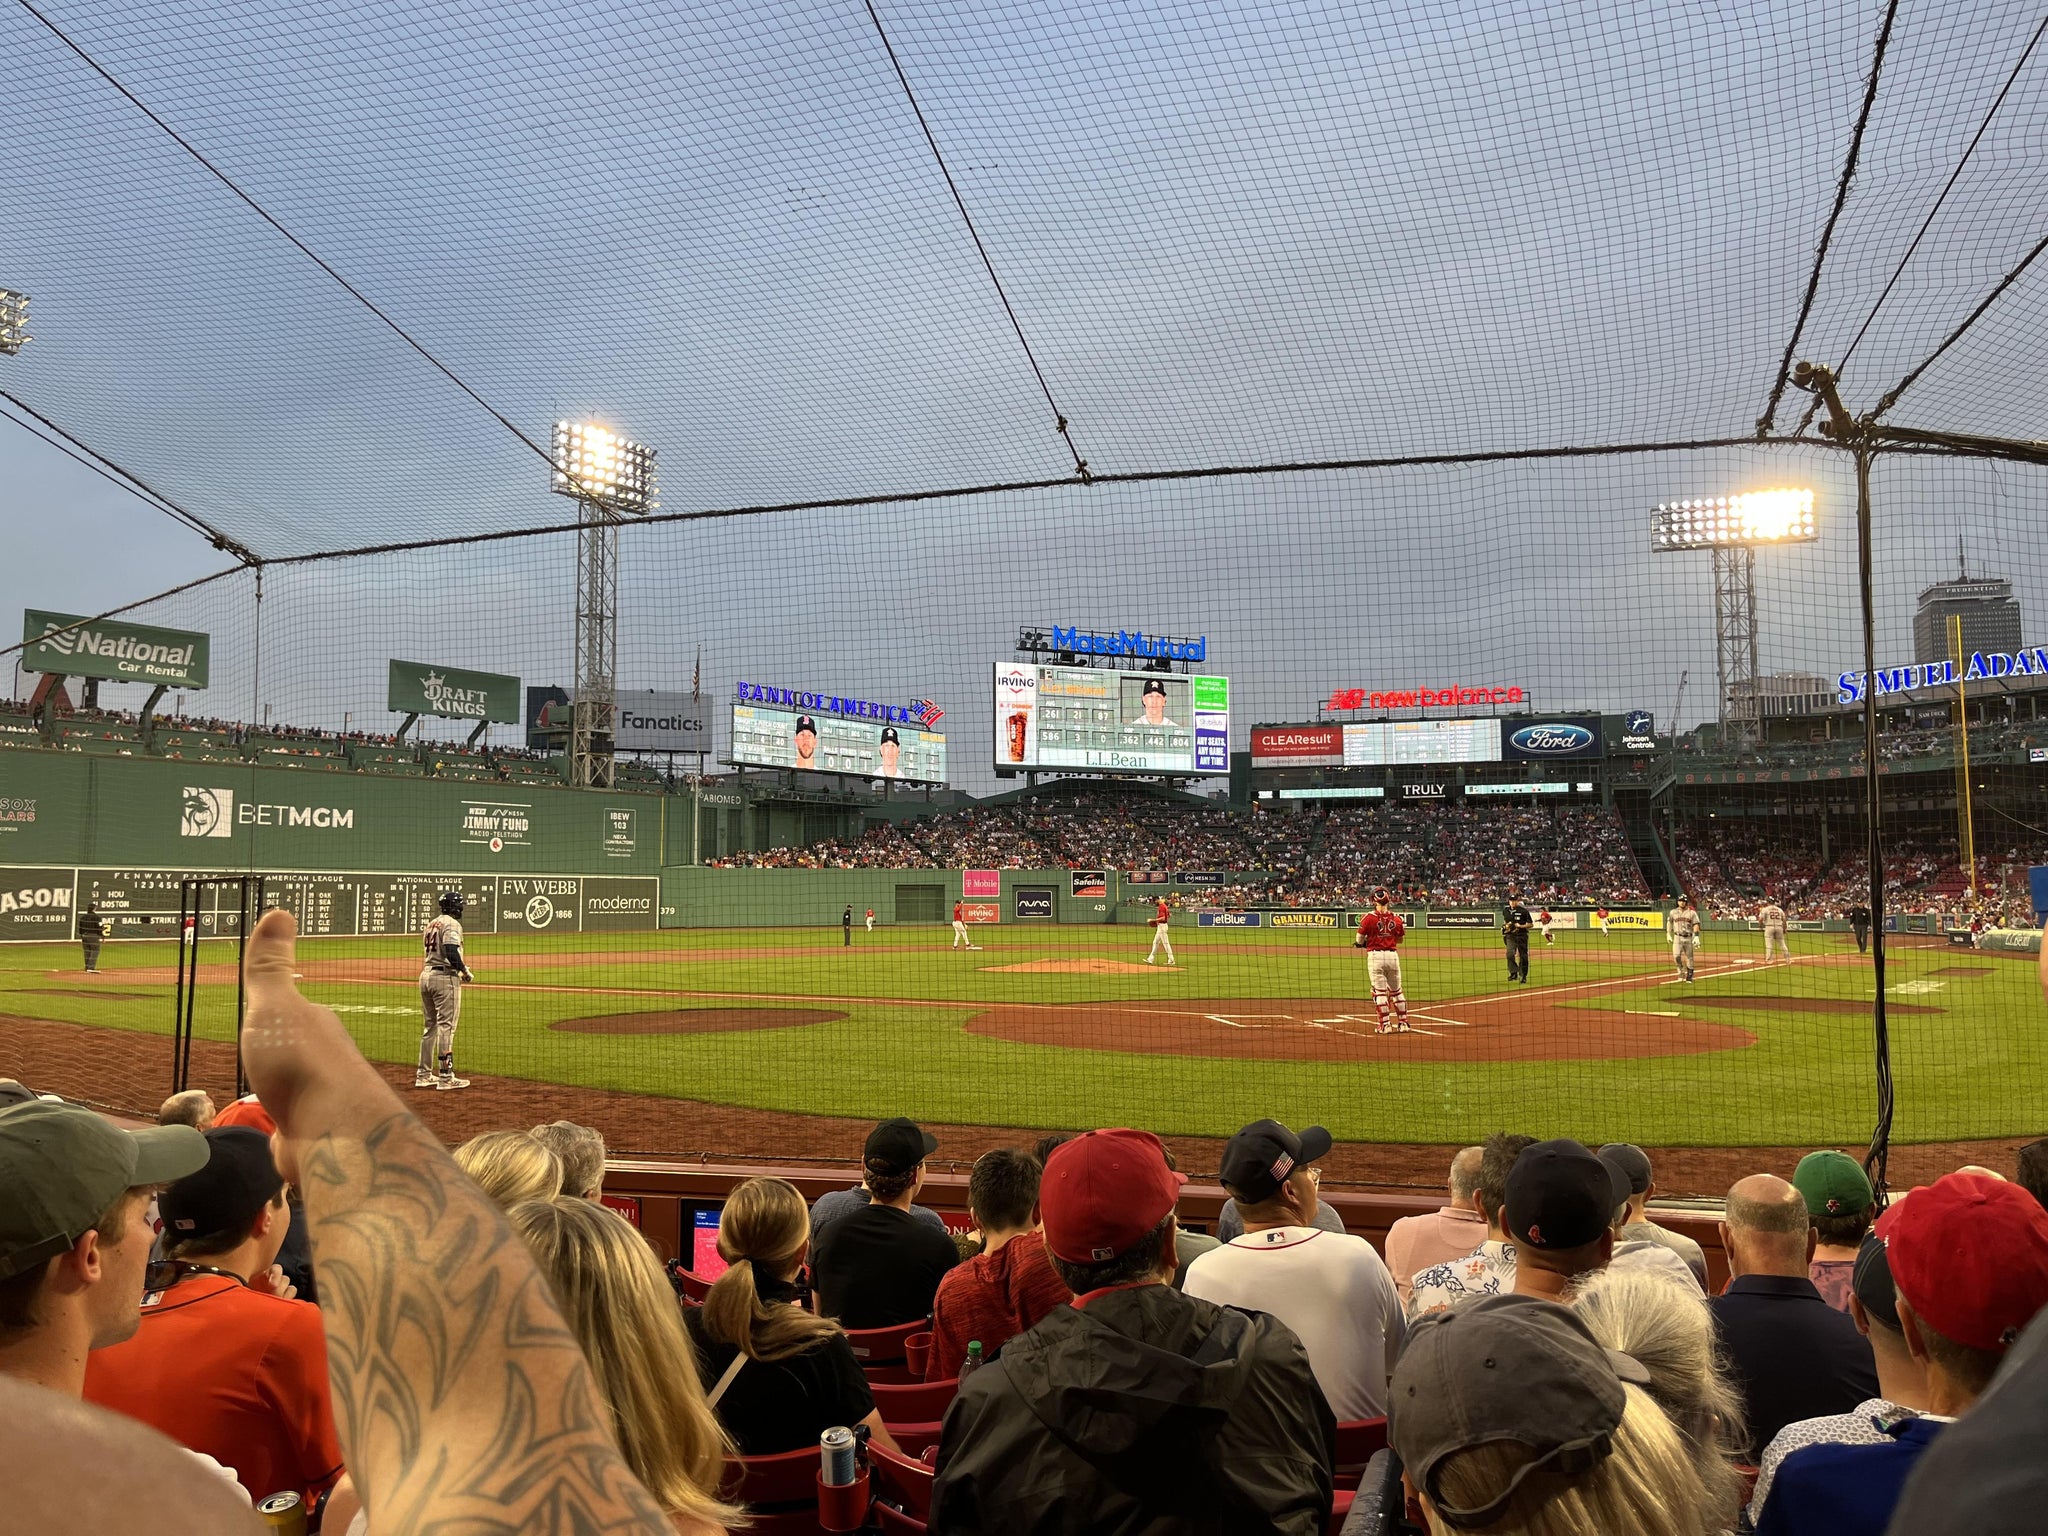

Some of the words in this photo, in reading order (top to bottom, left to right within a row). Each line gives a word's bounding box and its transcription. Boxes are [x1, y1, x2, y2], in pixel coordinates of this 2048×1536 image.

[1946, 585, 2000, 594] PRUDENTIAL
[76, 630, 195, 666] National
[1052, 624, 1207, 662] MassMutual
[118, 661, 141, 673] Car
[145, 664, 188, 678] Rental
[997, 677, 1035, 688] IRVING
[1837, 660, 1960, 704] SAMUEL
[424, 684, 488, 703] DRAFT
[1370, 690, 1417, 709] new
[1420, 683, 1523, 707] balance
[432, 698, 486, 716] KINGS
[738, 681, 795, 706] BANK
[802, 692, 824, 711] OF
[829, 696, 911, 724] AMERICA
[621, 711, 704, 732] Fanatics
[1042, 710, 1059, 719] .261
[1073, 710, 1082, 720] 21
[1098, 712, 1109, 721] 87
[1042, 732, 1060, 741] 586
[1075, 734, 1080, 742] 3
[1100, 734, 1106, 743] 0
[1120, 736, 1139, 745] .362
[1145, 737, 1164, 746] .442
[1170, 738, 1189, 748] .804
[1196, 736, 1208, 746] ANY
[1262, 733, 1332, 746] CLEAResult
[1526, 728, 1578, 749] Ford
[1622, 735, 1650, 744] Johnson
[1198, 746, 1209, 756] ANY
[828, 757, 834, 767] 0
[846, 758, 851, 769] 0
[1085, 751, 1148, 768] L.L.Bean
[1200, 756, 1210, 766] ANY
[1402, 784, 1446, 795] TRULY
[0, 798, 37, 812] SOX
[703, 793, 742, 805] ABIOMED
[238, 803, 354, 829] BETMGM
[610, 812, 630, 820] IBEW
[462, 816, 500, 830] JIMMY
[502, 818, 529, 832] FUND
[614, 822, 627, 830] 103
[114, 872, 172, 880] FENWAY
[1074, 878, 1105, 886] Safelite
[532, 880, 577, 895] WEBB
[974, 879, 997, 888] Mobile
[108, 890, 124, 898] HOU
[588, 895, 651, 909] moderna
[504, 910, 523, 920] Since
[555, 910, 572, 919] 1866
[660, 907, 676, 915] 379
[968, 909, 994, 917] IRVING
[1770, 912, 1780, 920] 22
[14, 915, 43, 923] SINCE
[46, 914, 67, 922] 1898
[1212, 914, 1246, 926] jetBlue
[1273, 914, 1313, 924] GRANITE
[1314, 913, 1336, 926] CITY
[1605, 916, 1634, 926] WISTED
[425, 932, 438, 952] 44
